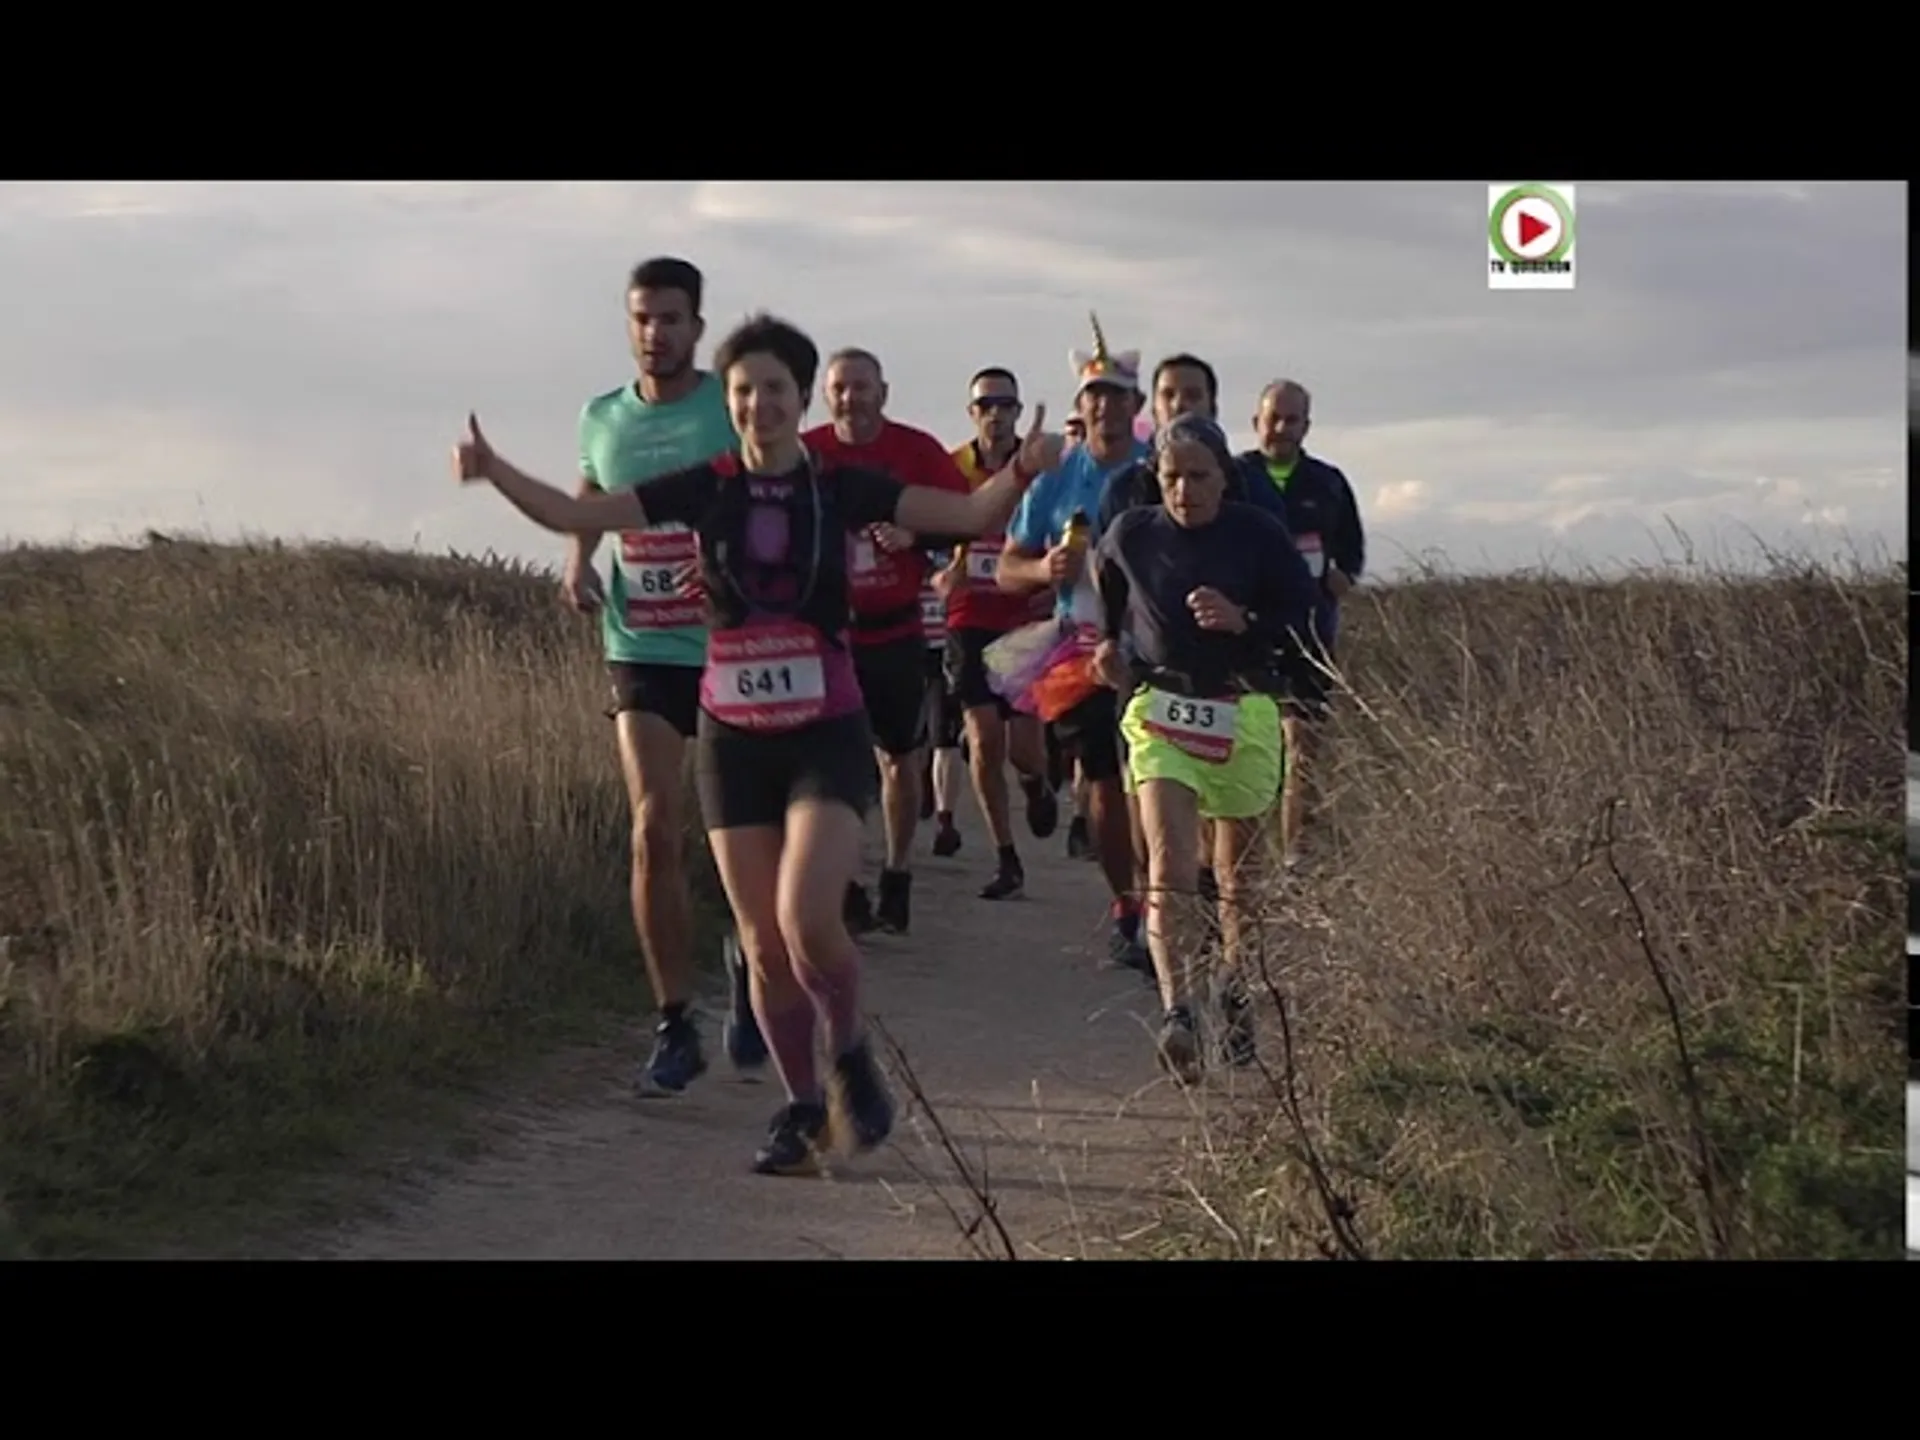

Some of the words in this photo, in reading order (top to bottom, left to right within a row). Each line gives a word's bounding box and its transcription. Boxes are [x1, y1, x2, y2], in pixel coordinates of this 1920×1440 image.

[641, 569, 682, 593] 68
[736, 664, 792, 698] 641
[1166, 699, 1215, 728] 633
